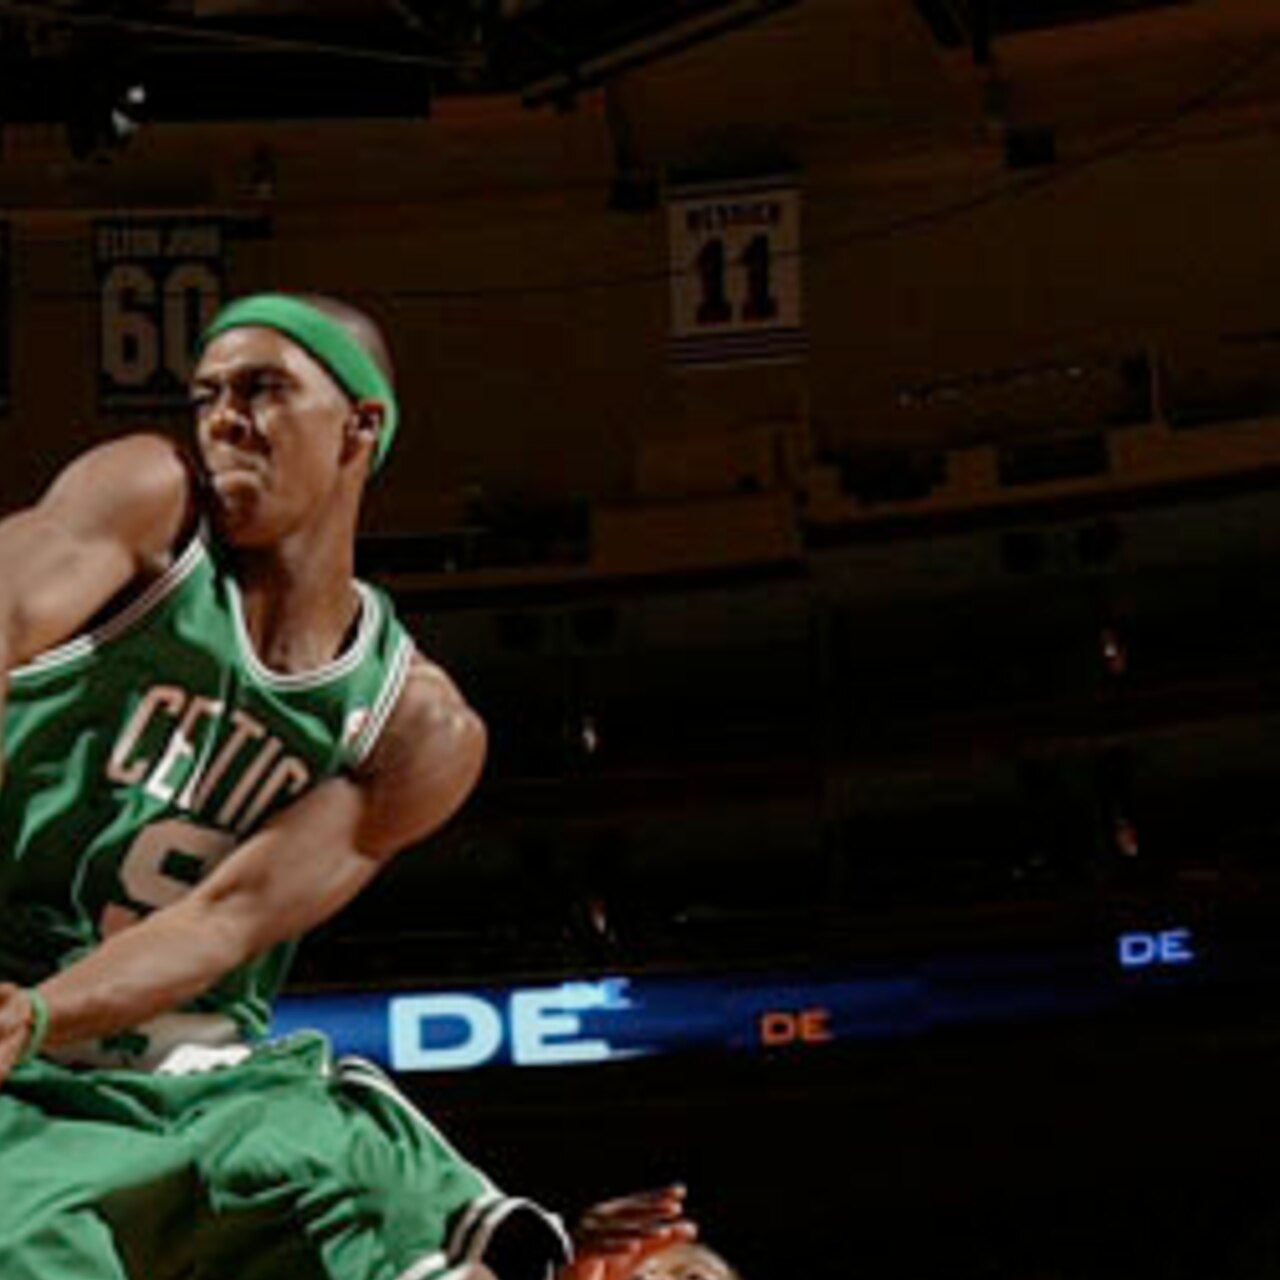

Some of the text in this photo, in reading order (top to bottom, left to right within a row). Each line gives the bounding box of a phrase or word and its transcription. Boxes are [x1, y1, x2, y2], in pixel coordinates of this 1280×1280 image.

[102, 263, 220, 386] 60
[696, 234, 776, 326] 11
[106, 683, 310, 834] CELTIC
[1118, 926, 1194, 965] DE
[389, 985, 610, 1072] DE
[760, 1009, 833, 1046] DE
